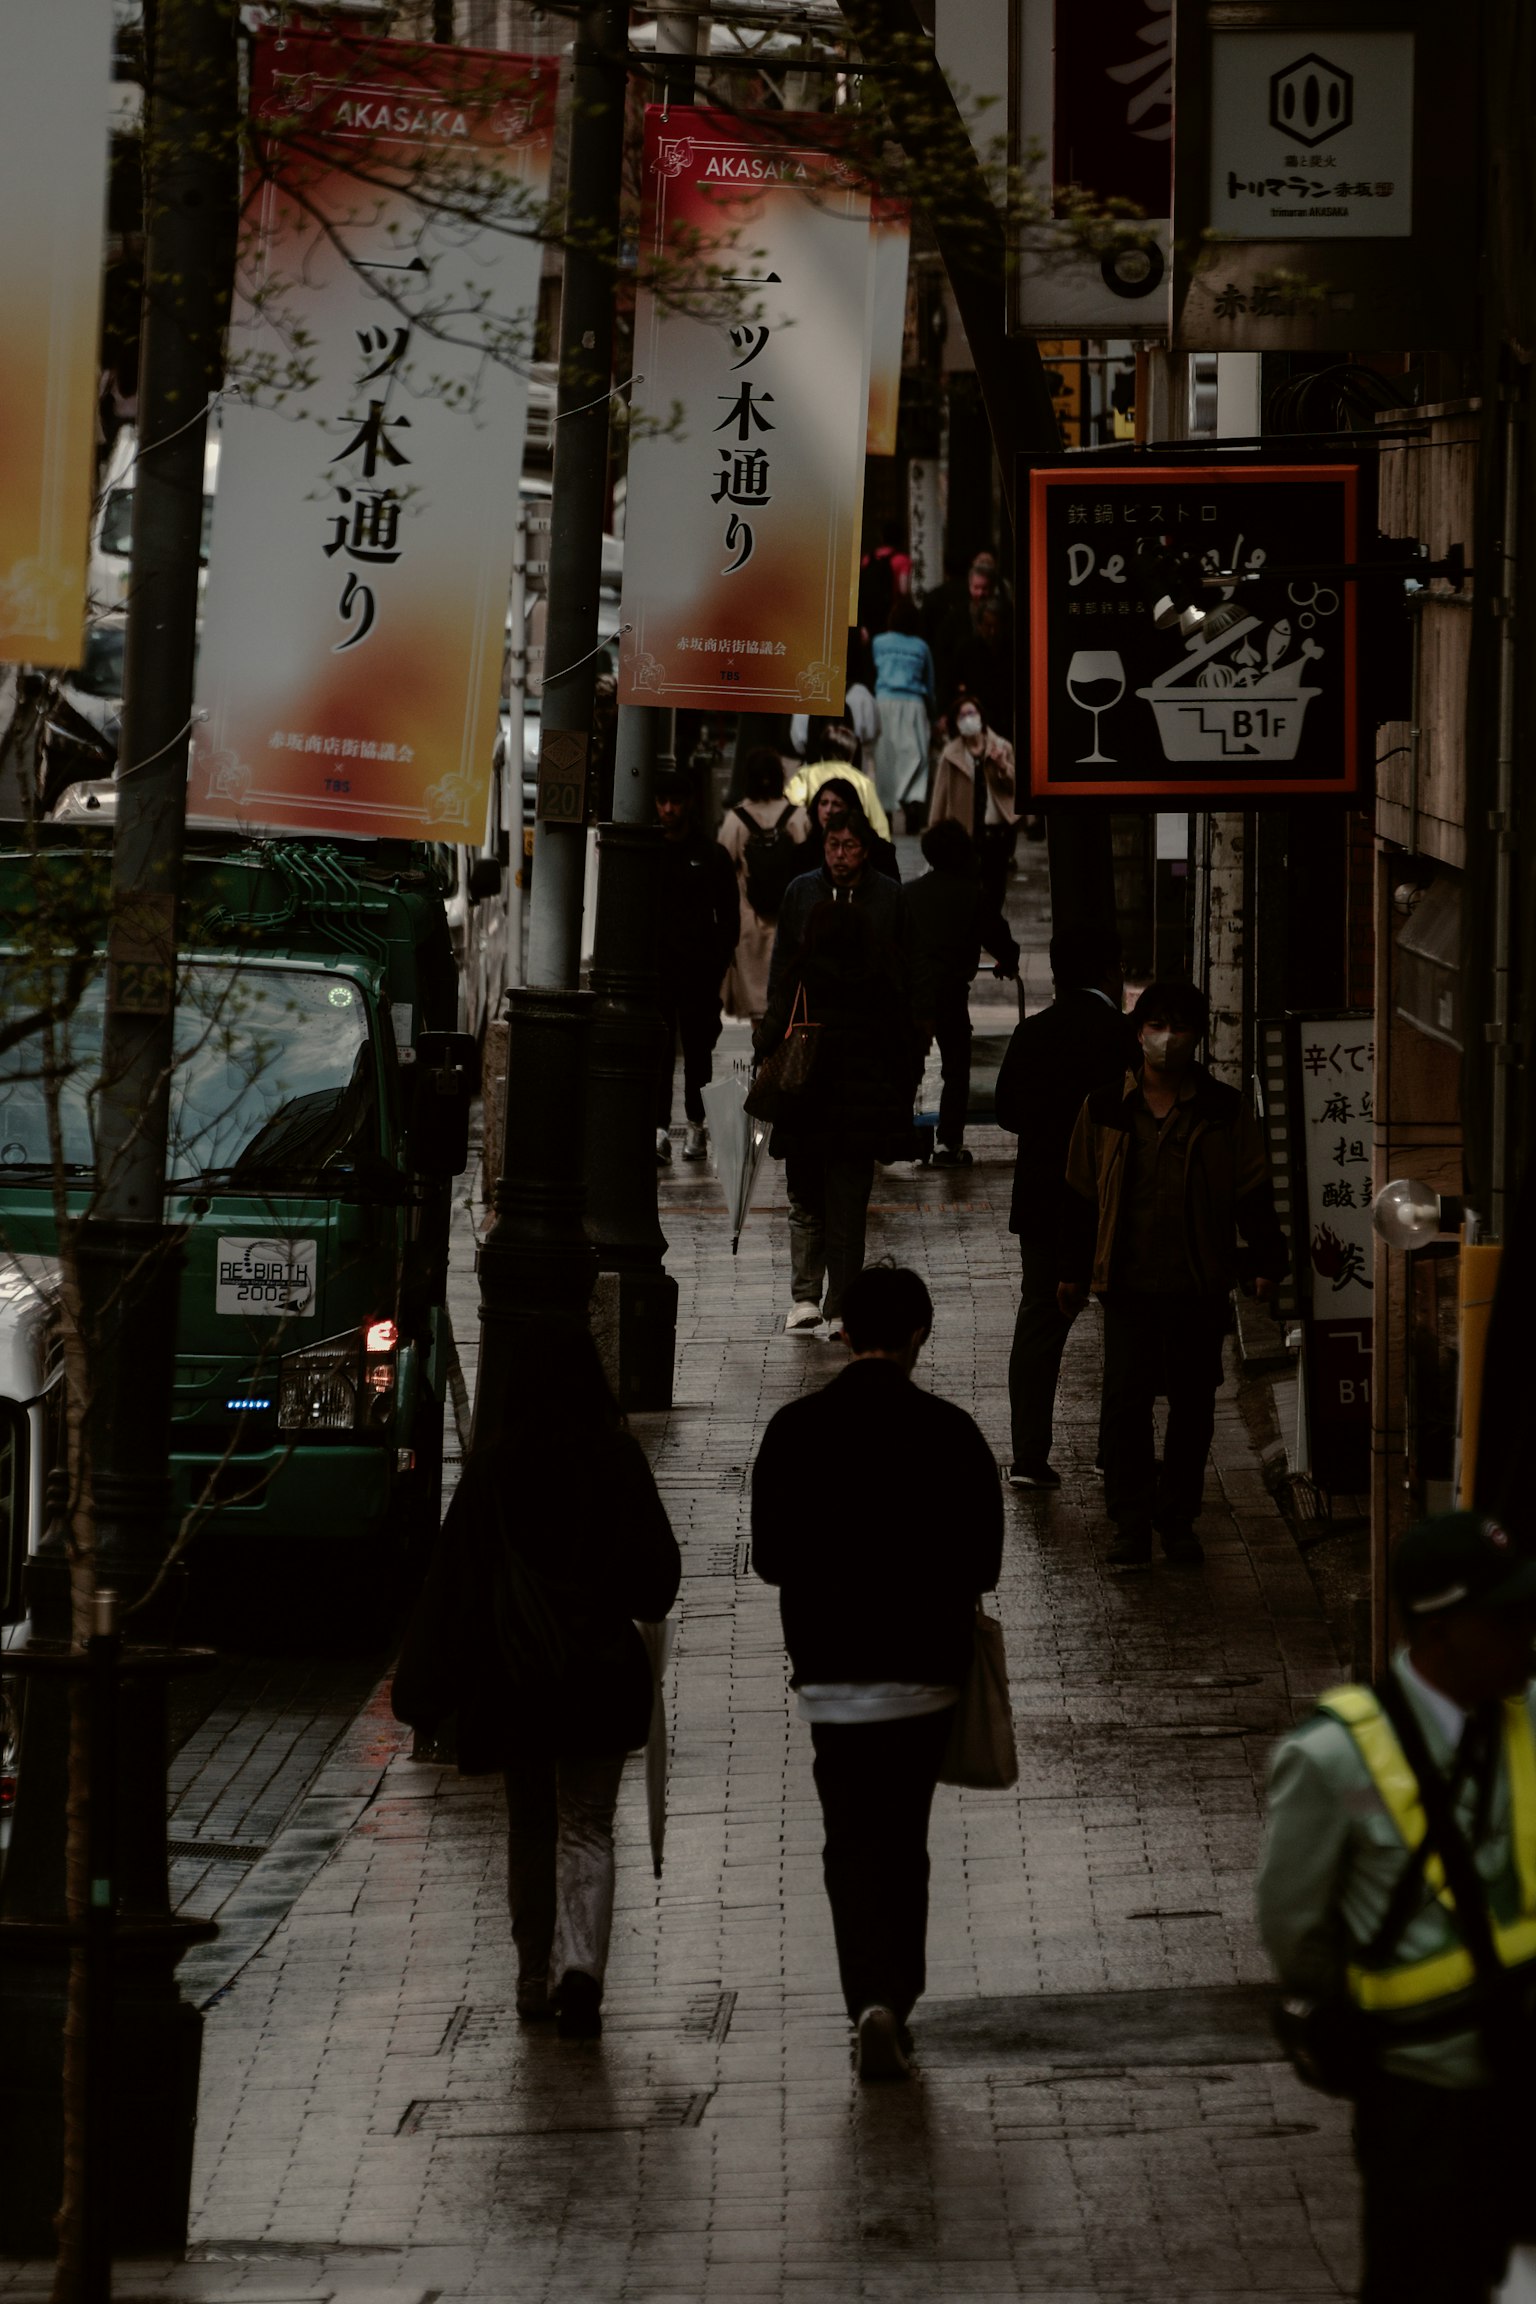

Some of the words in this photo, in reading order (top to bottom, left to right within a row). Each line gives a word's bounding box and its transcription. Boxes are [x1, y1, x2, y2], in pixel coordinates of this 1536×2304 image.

[335, 101, 469, 137] AKASAKA
[705, 157, 808, 179] AKASAKA
[1309, 207, 1349, 217] AKASAKA
[711, 272, 782, 573] 一ツ木通り
[323, 258, 428, 650] 一ツ木通り
[1068, 504, 1217, 525] 鉄鍋ビストロ
[677, 637, 787, 656] 赤坂商店街協議会
[720, 671, 740, 681] TBS
[1234, 709, 1286, 737] B1F
[268, 730, 415, 763] 赤坂商店街協議会
[324, 778, 351, 792] TBS
[545, 784, 576, 815] 20
[237, 1285, 290, 1301] 2002
